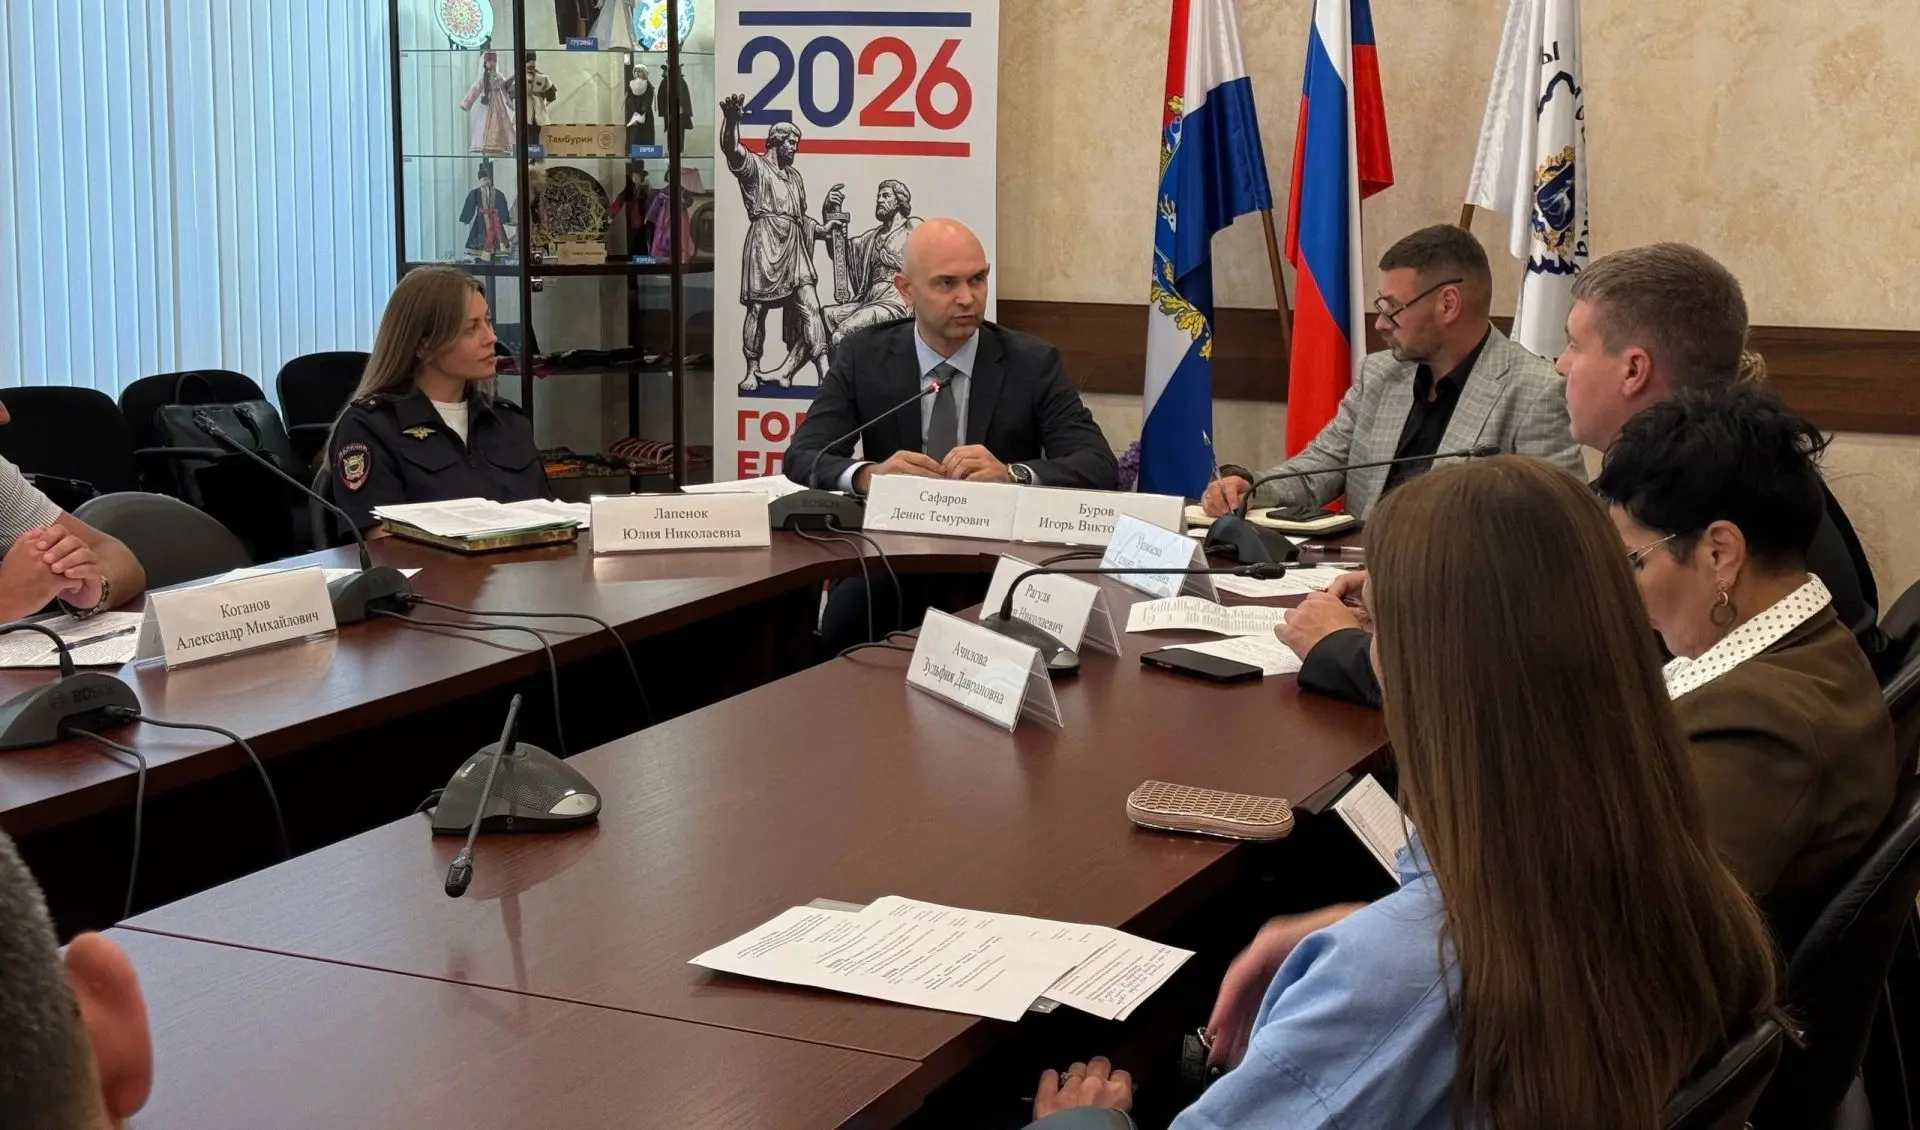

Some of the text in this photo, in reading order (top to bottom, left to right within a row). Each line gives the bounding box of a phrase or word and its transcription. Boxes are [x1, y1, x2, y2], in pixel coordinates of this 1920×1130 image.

[737, 36, 972, 130] 2026
[547, 135, 594, 145] Тамбурин
[920, 490, 967, 506] Сафаров
[653, 508, 709, 519] Лапенок
[890, 507, 990, 527] Денис Темурович
[1079, 503, 1115, 518] Буров
[623, 527, 742, 540] Юлия Николаевна
[1039, 516, 1115, 534] Игорь Викто
[1024, 584, 1051, 603] Рагуля
[220, 600, 270, 618] Коганов
[1019, 607, 1063, 634] Николаевич
[176, 612, 319, 650] Александр Михайлович
[952, 641, 988, 667] Ачилова
[922, 657, 1005, 704] Зульфия Даврановна
